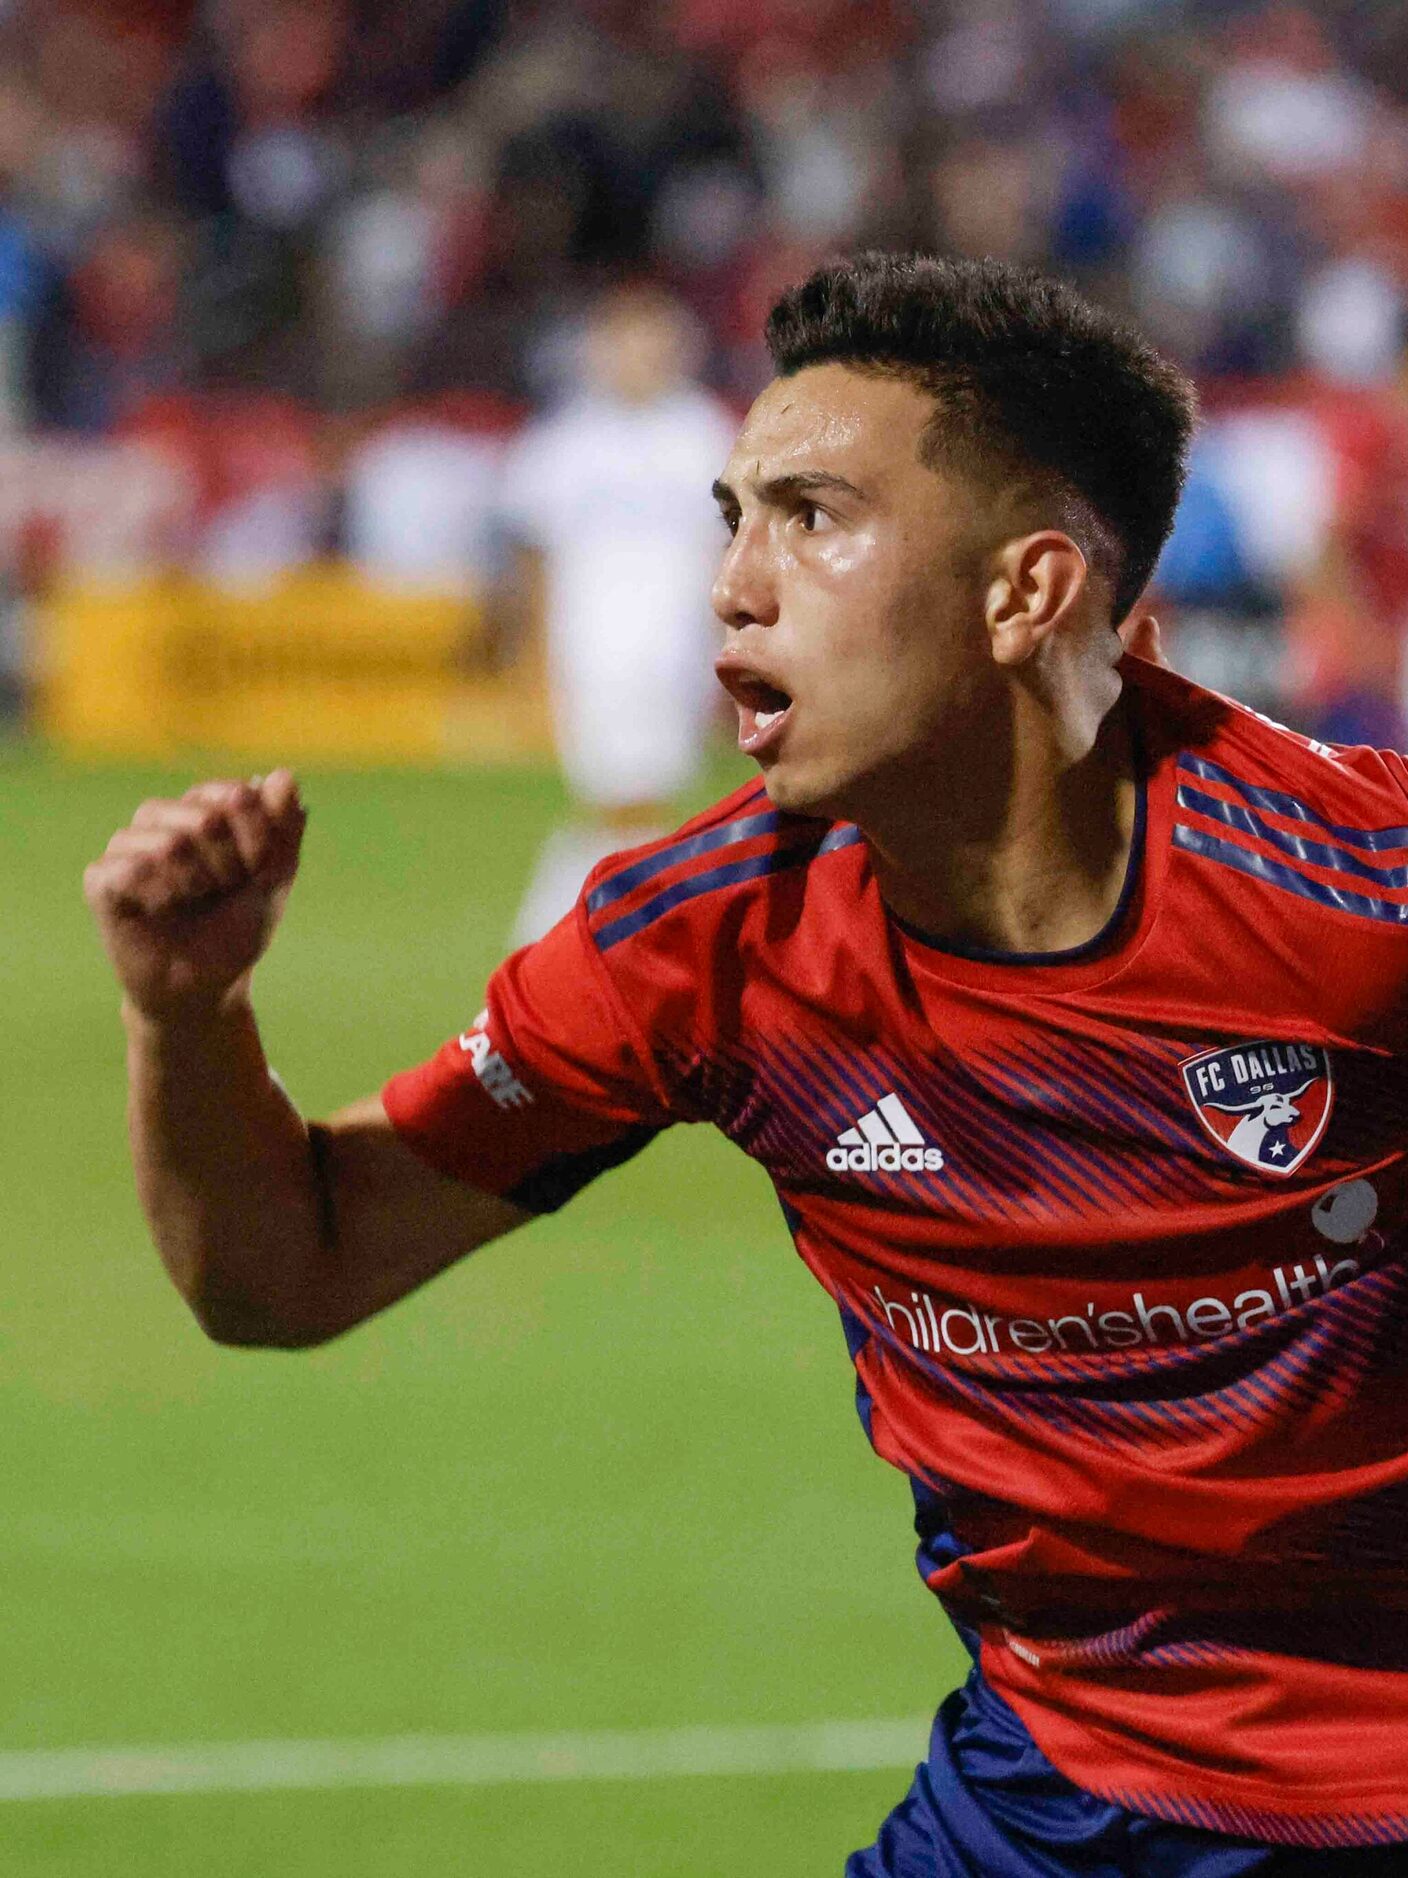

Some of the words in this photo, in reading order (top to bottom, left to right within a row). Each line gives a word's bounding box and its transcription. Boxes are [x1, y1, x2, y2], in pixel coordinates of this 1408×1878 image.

[1196, 1061, 1226, 1098] FC
[1230, 1044, 1318, 1085] DALLAS
[826, 1142, 944, 1172] adidas
